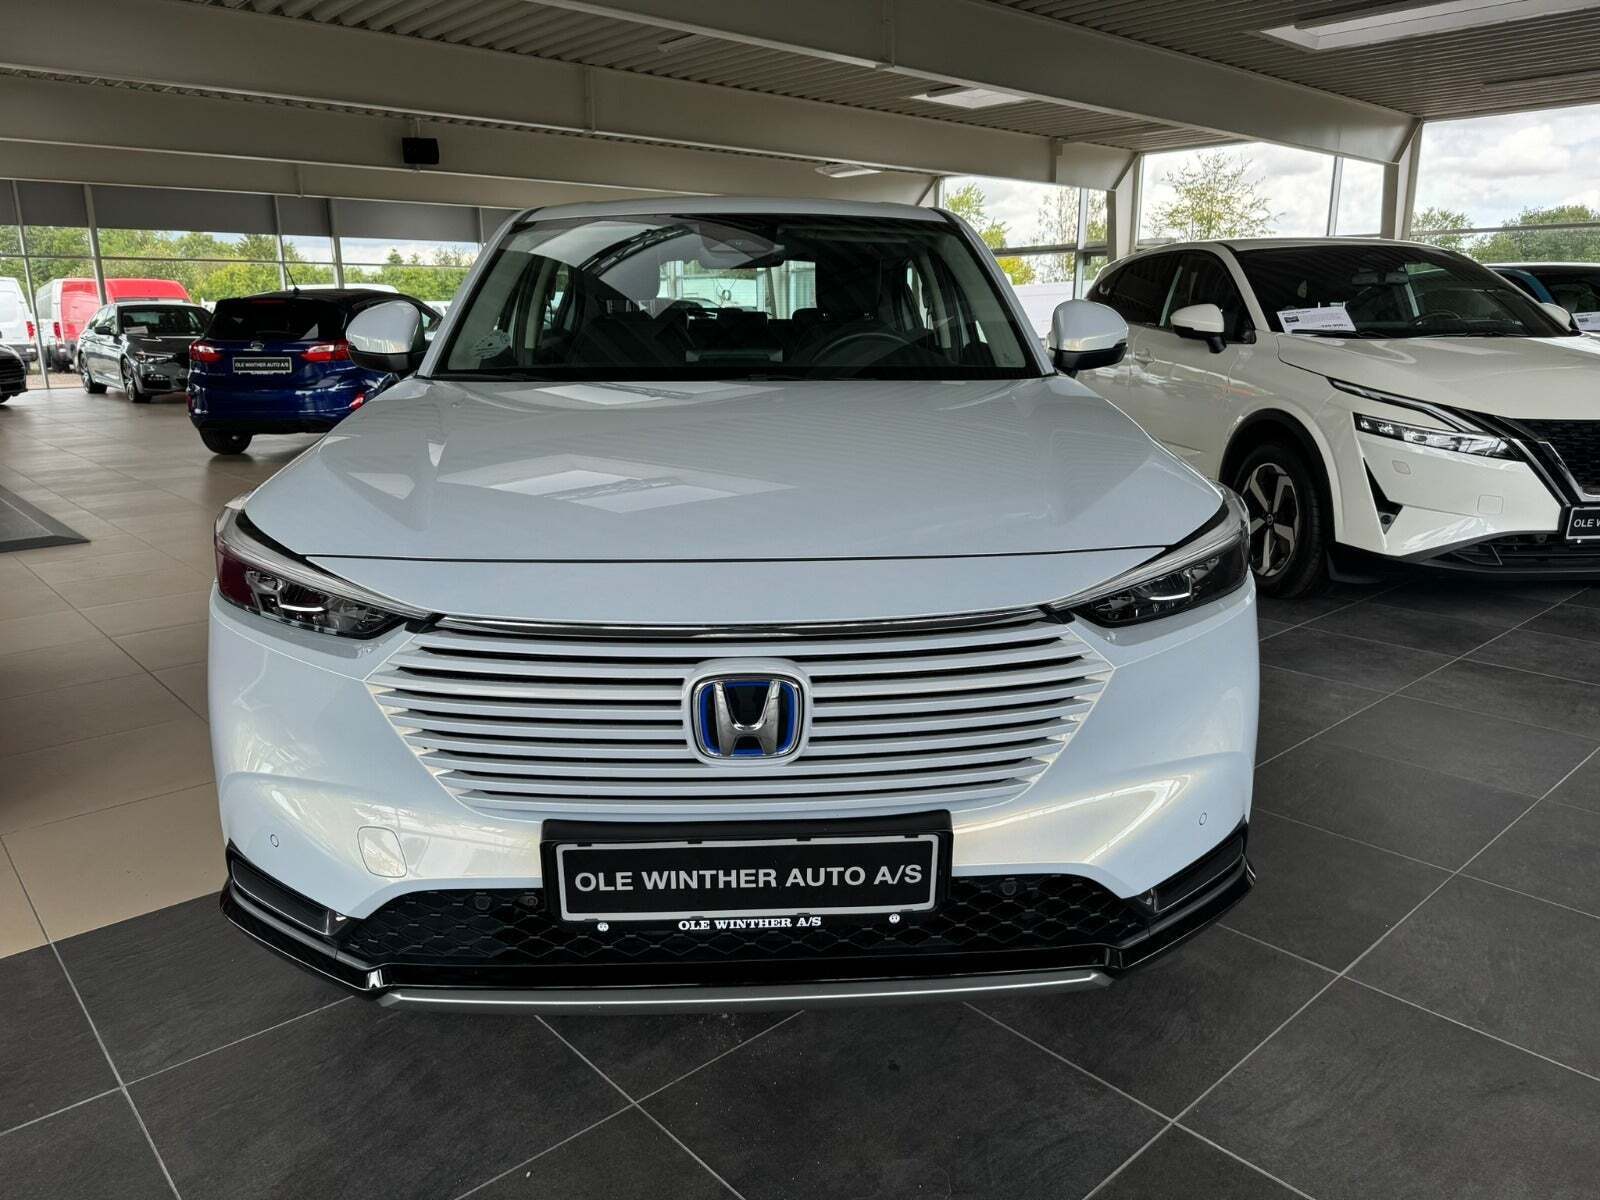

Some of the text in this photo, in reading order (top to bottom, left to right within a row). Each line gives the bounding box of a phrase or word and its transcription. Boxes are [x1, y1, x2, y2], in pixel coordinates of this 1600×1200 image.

[1573, 518, 1595, 528] OLE
[575, 864, 922, 892] OLE WINTHER AUTO A/S
[678, 916, 822, 931] OLE WINTHER A/S
